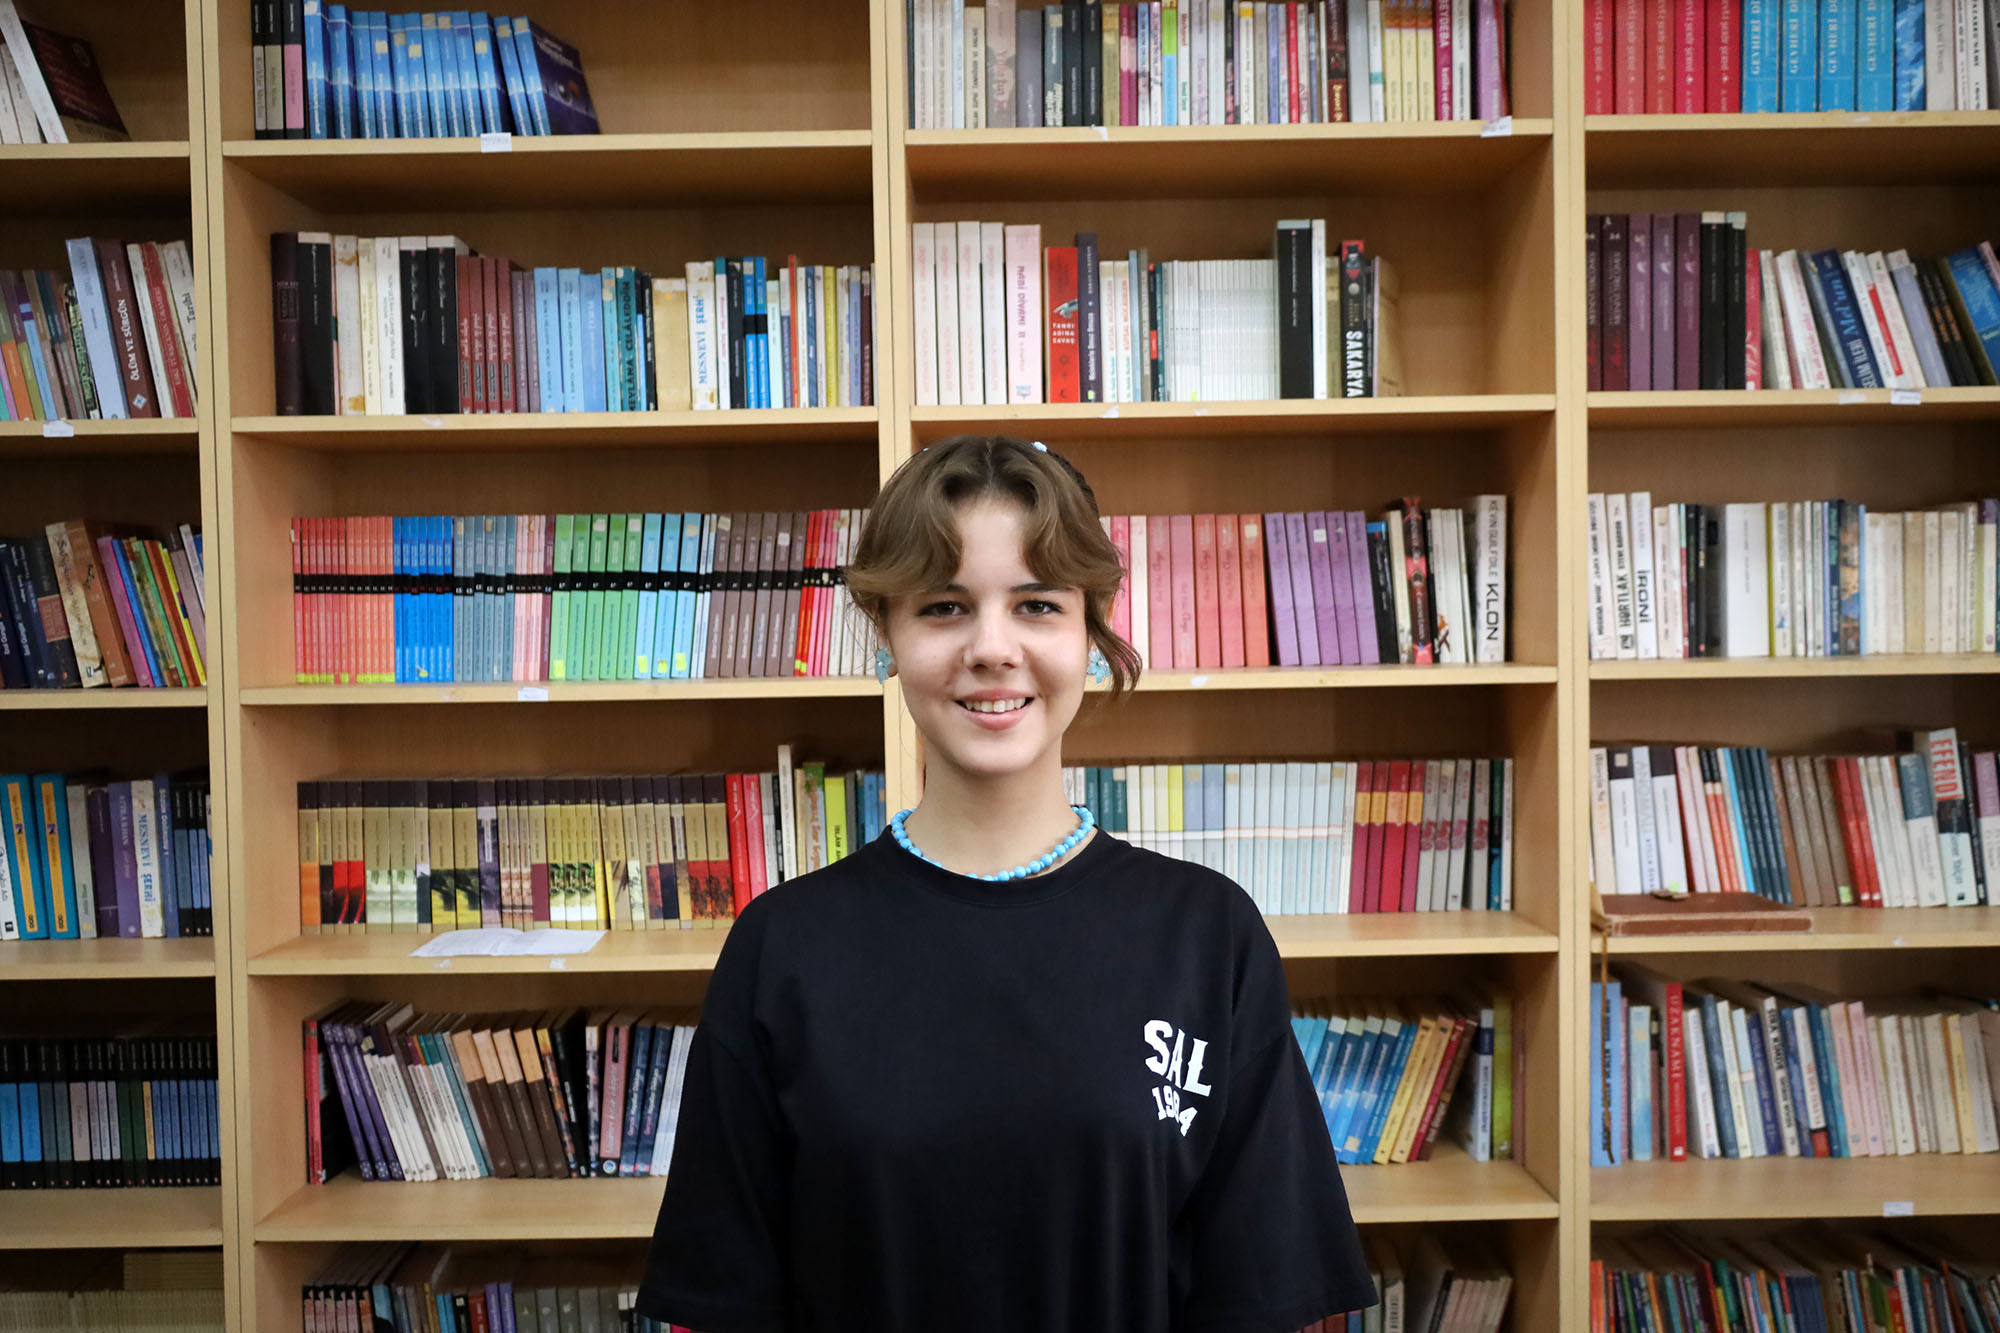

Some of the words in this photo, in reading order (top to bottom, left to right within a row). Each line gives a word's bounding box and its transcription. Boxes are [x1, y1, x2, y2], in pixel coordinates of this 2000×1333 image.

[125, 339, 135, 352] VE
[1346, 330, 1364, 398] SAKARYA
[1486, 583, 1500, 640] KLON
[1637, 569, 1652, 623] İRONİ
[1930, 738, 1965, 802] EFENDİ
[1144, 1019, 1212, 1097] SAL
